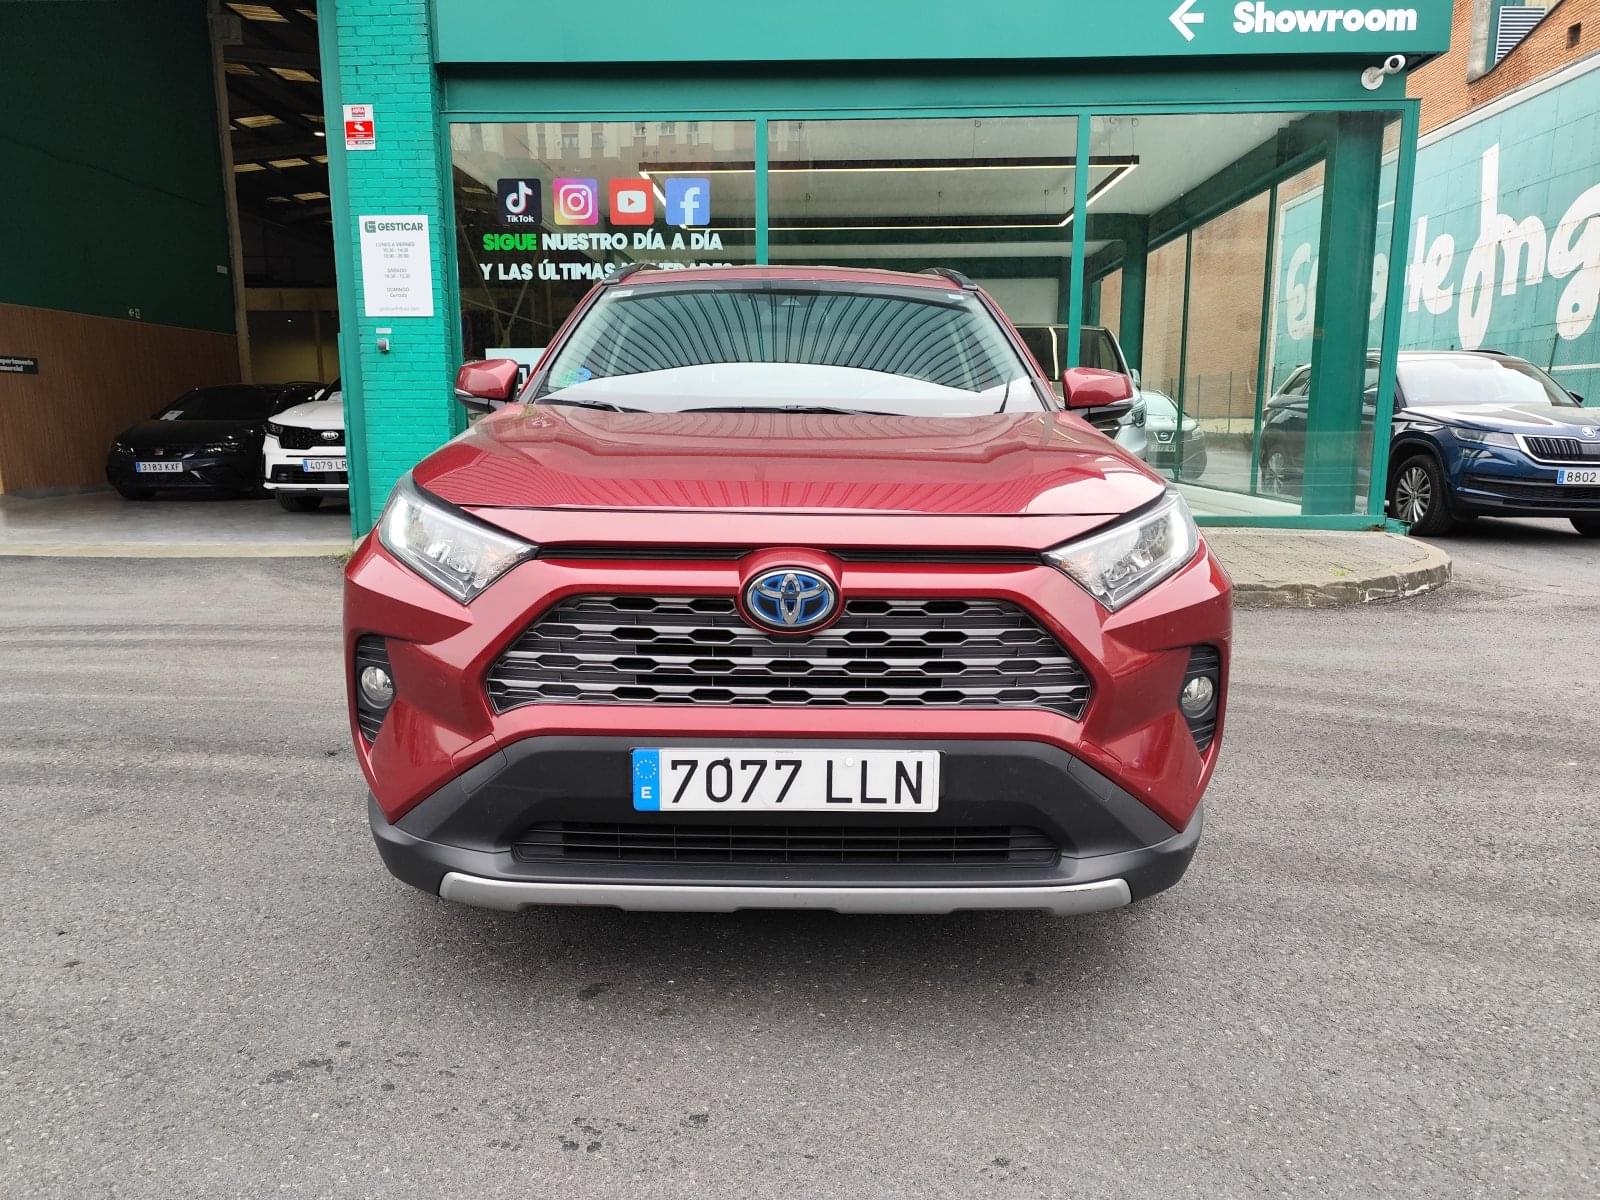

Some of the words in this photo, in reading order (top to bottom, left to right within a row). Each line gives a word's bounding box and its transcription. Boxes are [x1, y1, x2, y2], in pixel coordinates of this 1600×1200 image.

[1233, 1, 1417, 34] Showroom
[506, 215, 535, 223] TikTok
[377, 222, 424, 231] GESTICAR
[482, 233, 537, 251] SIGUE
[542, 233, 628, 251] NUESTRO
[634, 228, 666, 251] DÍA
[671, 233, 686, 251] A
[691, 228, 724, 251] DÍA
[480, 263, 497, 281] Y
[498, 263, 534, 281] LAS
[538, 258, 615, 281] ÚLTIMAS
[141, 463, 163, 471] 3183
[310, 461, 333, 470] 4079
[1566, 472, 1597, 482] 8802
[671, 758, 803, 803] 7077
[826, 759, 923, 804] LLN
[641, 787, 652, 798] E
